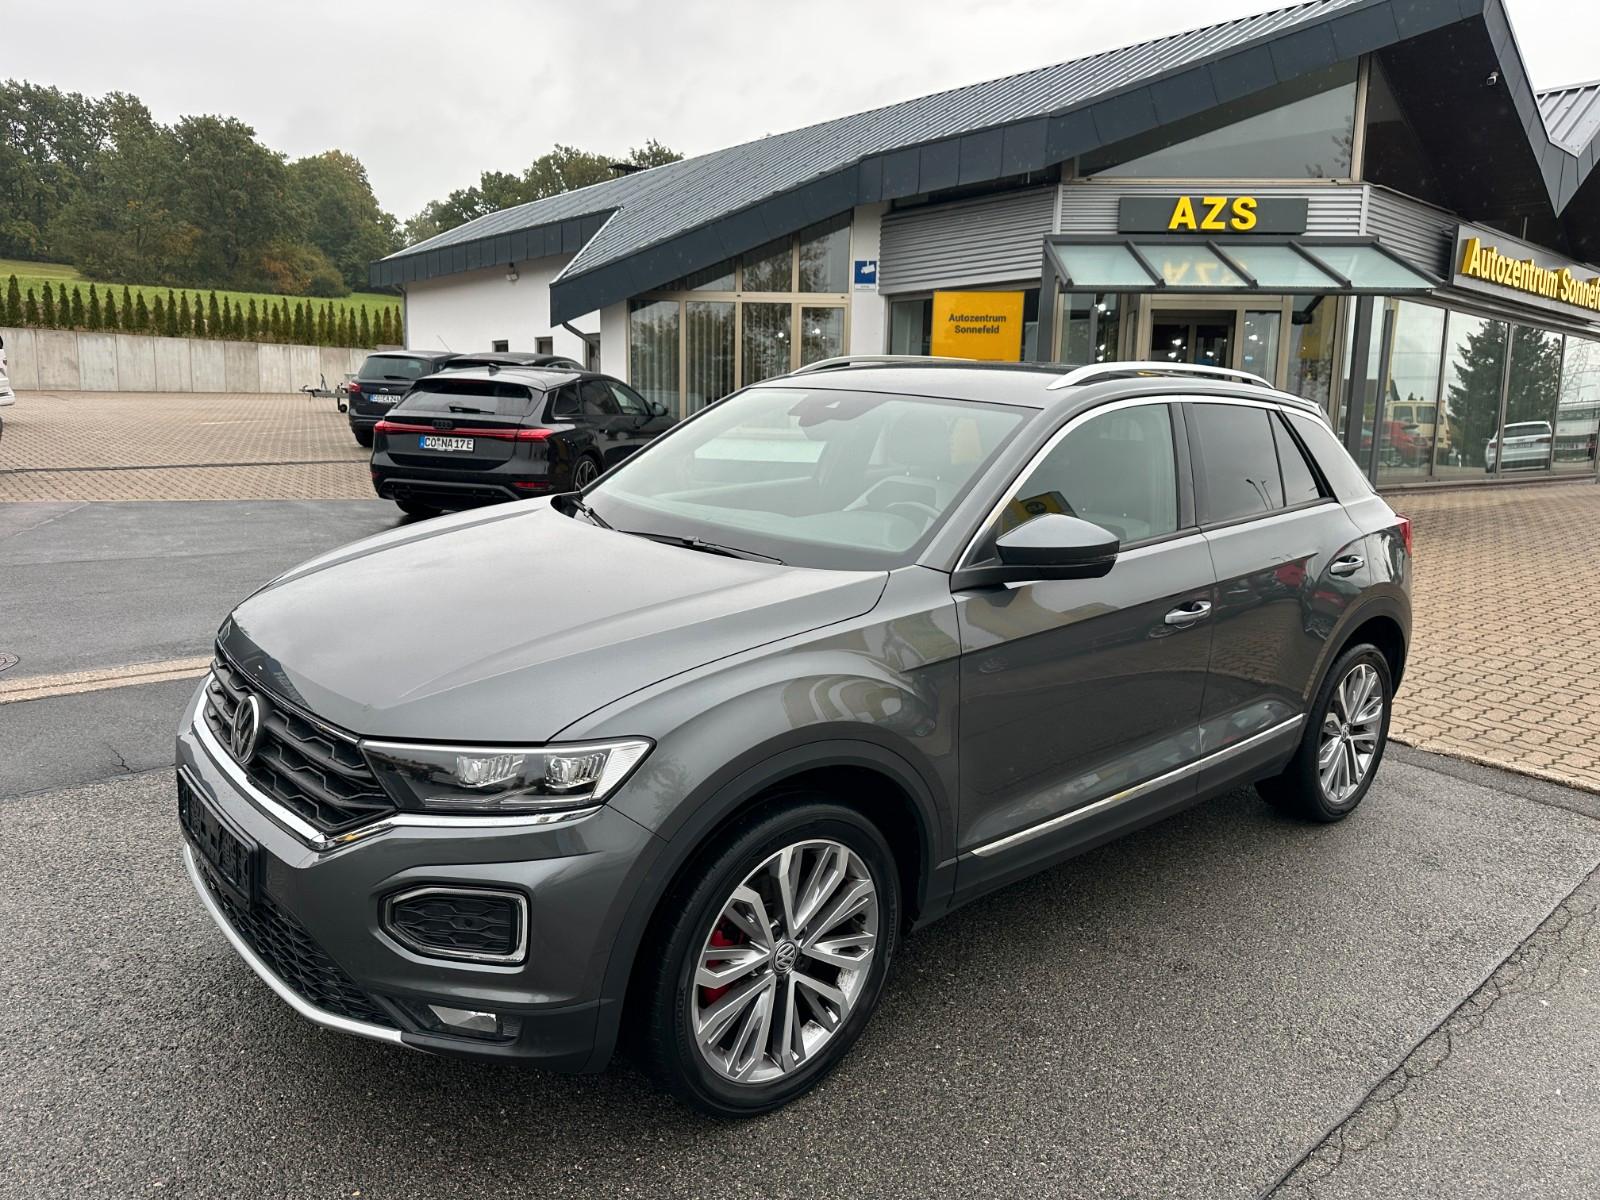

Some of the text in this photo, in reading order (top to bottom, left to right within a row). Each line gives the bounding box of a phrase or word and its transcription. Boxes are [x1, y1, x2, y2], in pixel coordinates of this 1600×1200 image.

[1168, 195, 1258, 230] AZS
[1462, 237, 1559, 298] Autozentrum
[948, 313, 1007, 322] Autozentrum
[954, 325, 1000, 334] Sonnefeld
